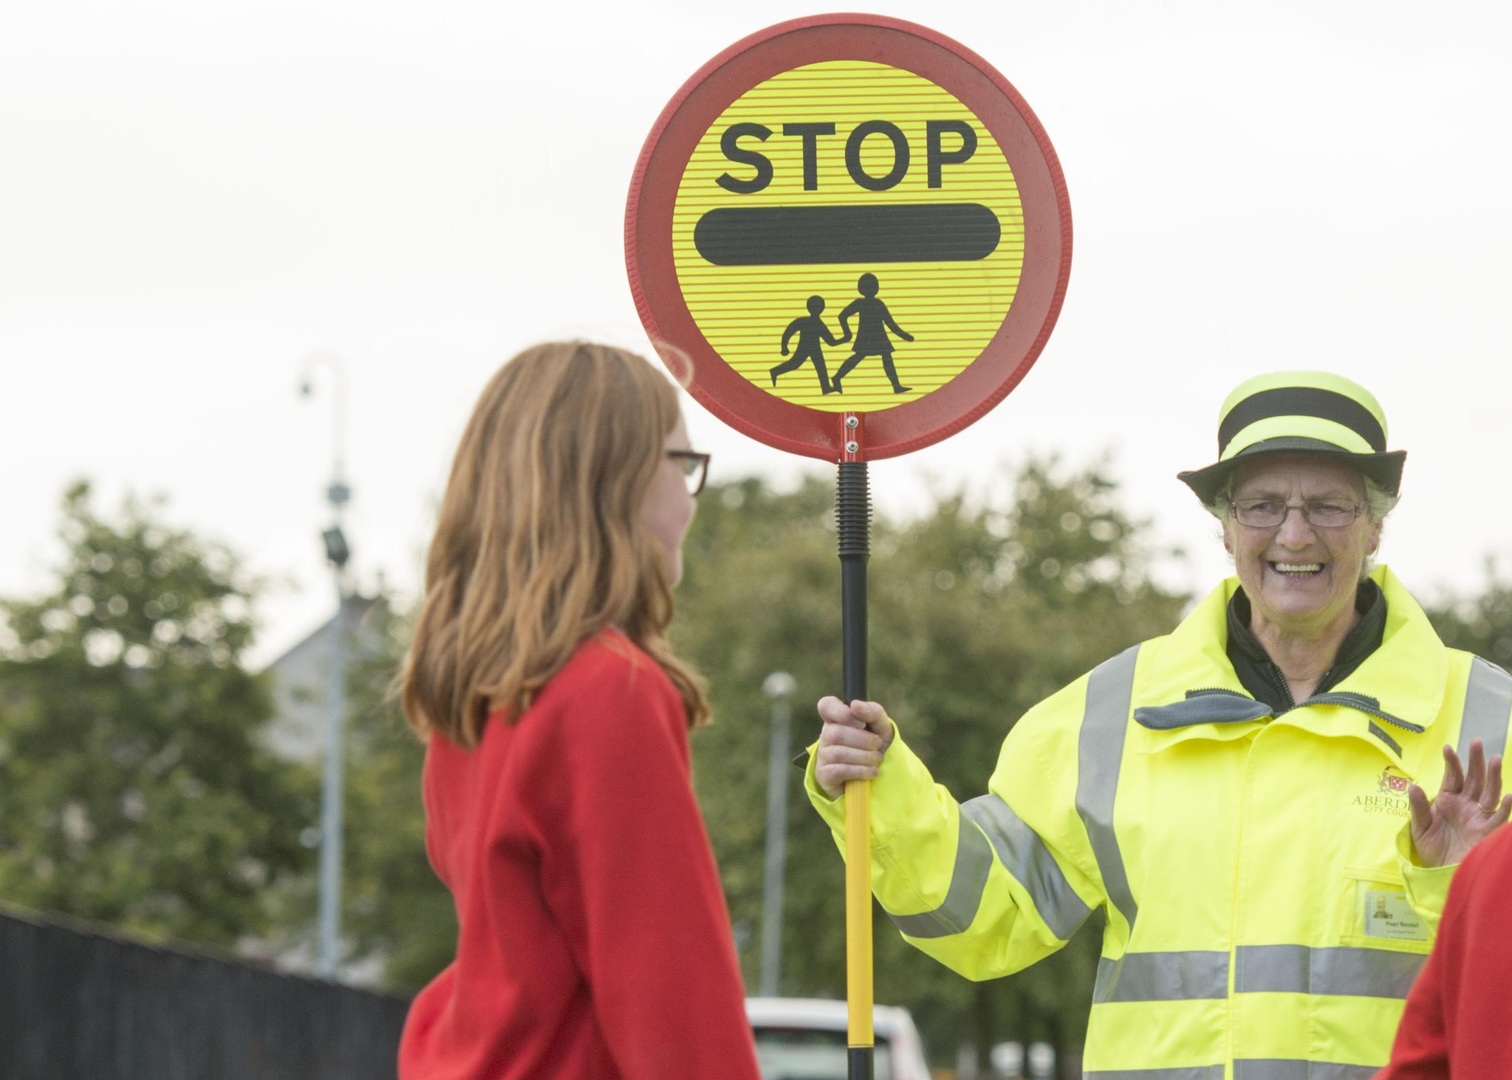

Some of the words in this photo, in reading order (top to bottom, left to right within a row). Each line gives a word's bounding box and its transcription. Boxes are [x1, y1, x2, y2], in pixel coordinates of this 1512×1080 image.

[716, 120, 977, 194] STOP
[1352, 795, 1411, 811] ABERD
[1364, 806, 1384, 814] CITY
